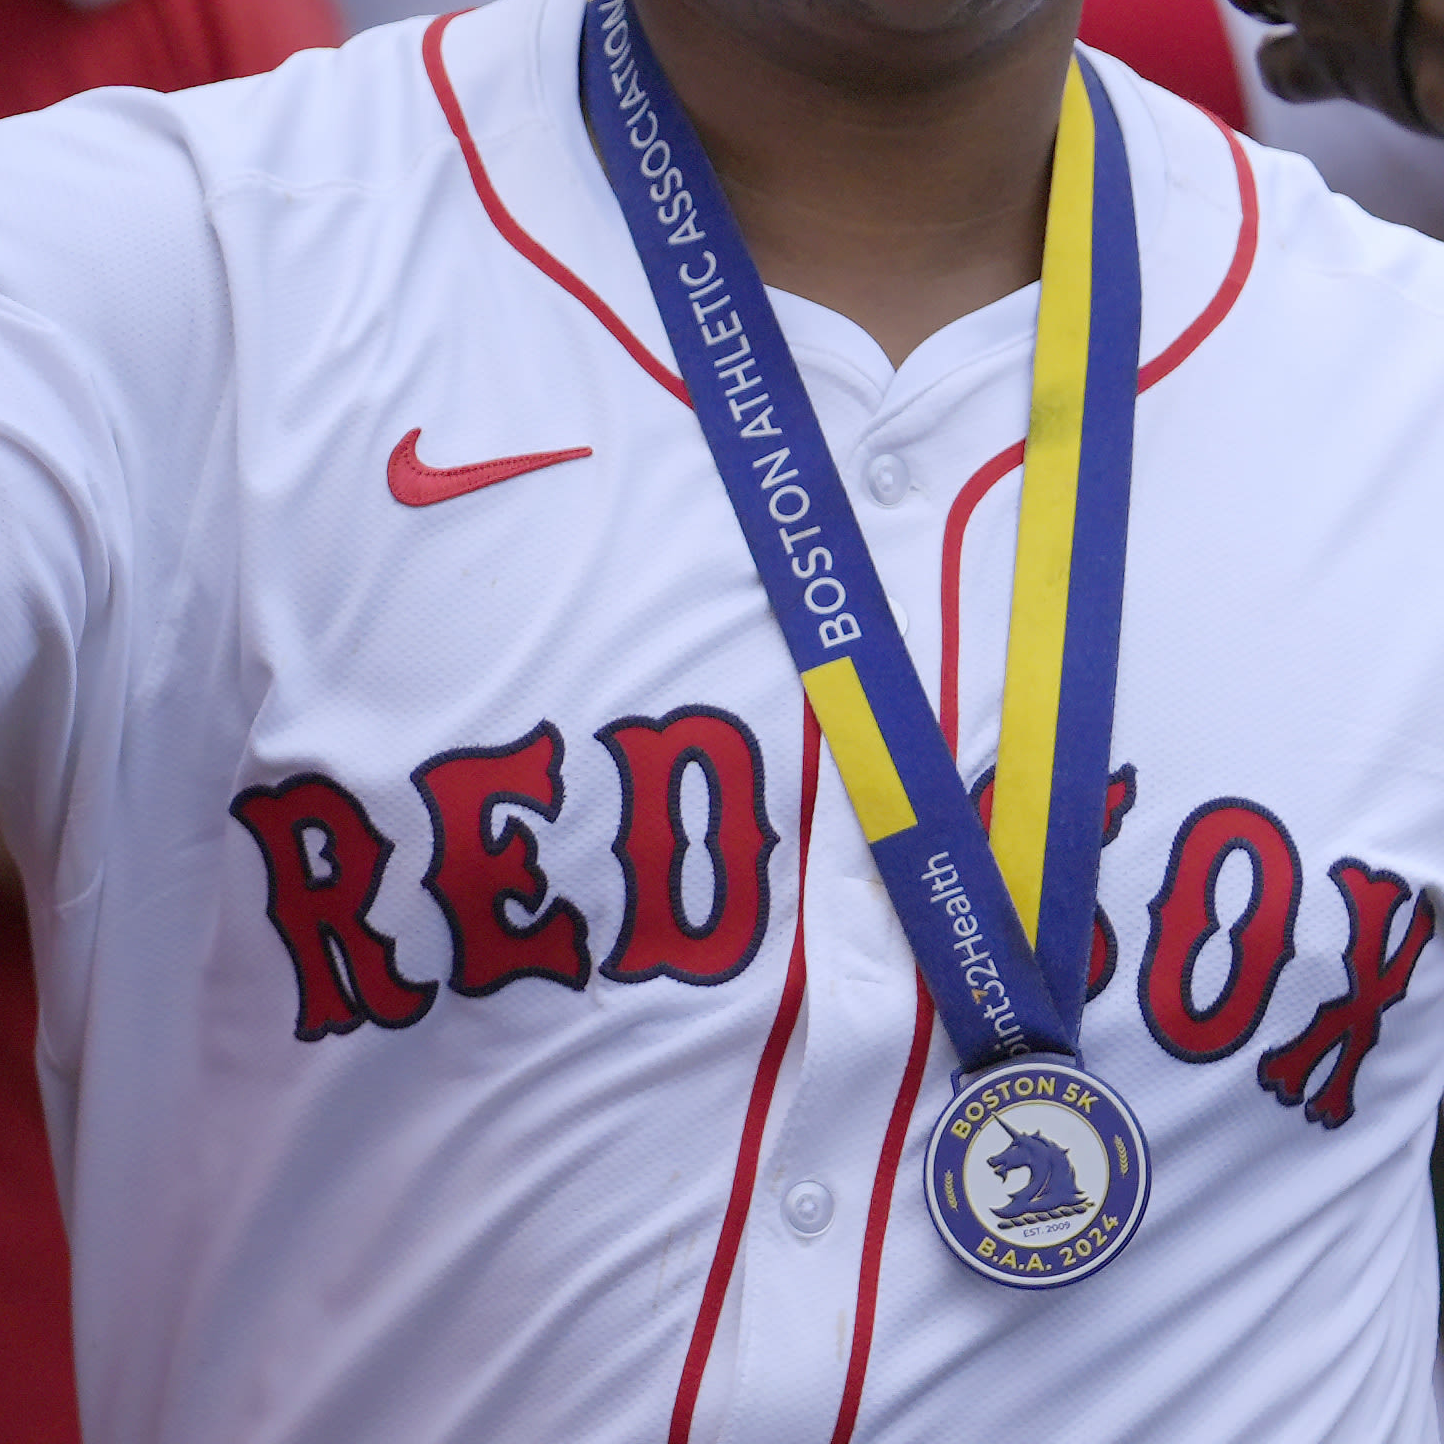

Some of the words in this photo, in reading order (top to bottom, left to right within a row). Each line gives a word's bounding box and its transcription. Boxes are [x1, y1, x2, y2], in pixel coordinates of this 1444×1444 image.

[678, 250, 781, 439] ATHLETIC
[752, 445, 861, 649] BOSTON
[231, 703, 780, 1041] RED
[971, 761, 1436, 1129] OX
[951, 1076, 1057, 1140] BOSTON
[1062, 1082, 1100, 1115] 5K
[976, 1236, 1053, 1272] B.A.A.
[1058, 1213, 1119, 1267] 2024
[1022, 1227, 1045, 1238] EST.
[1045, 1220, 1071, 1235] 2009
